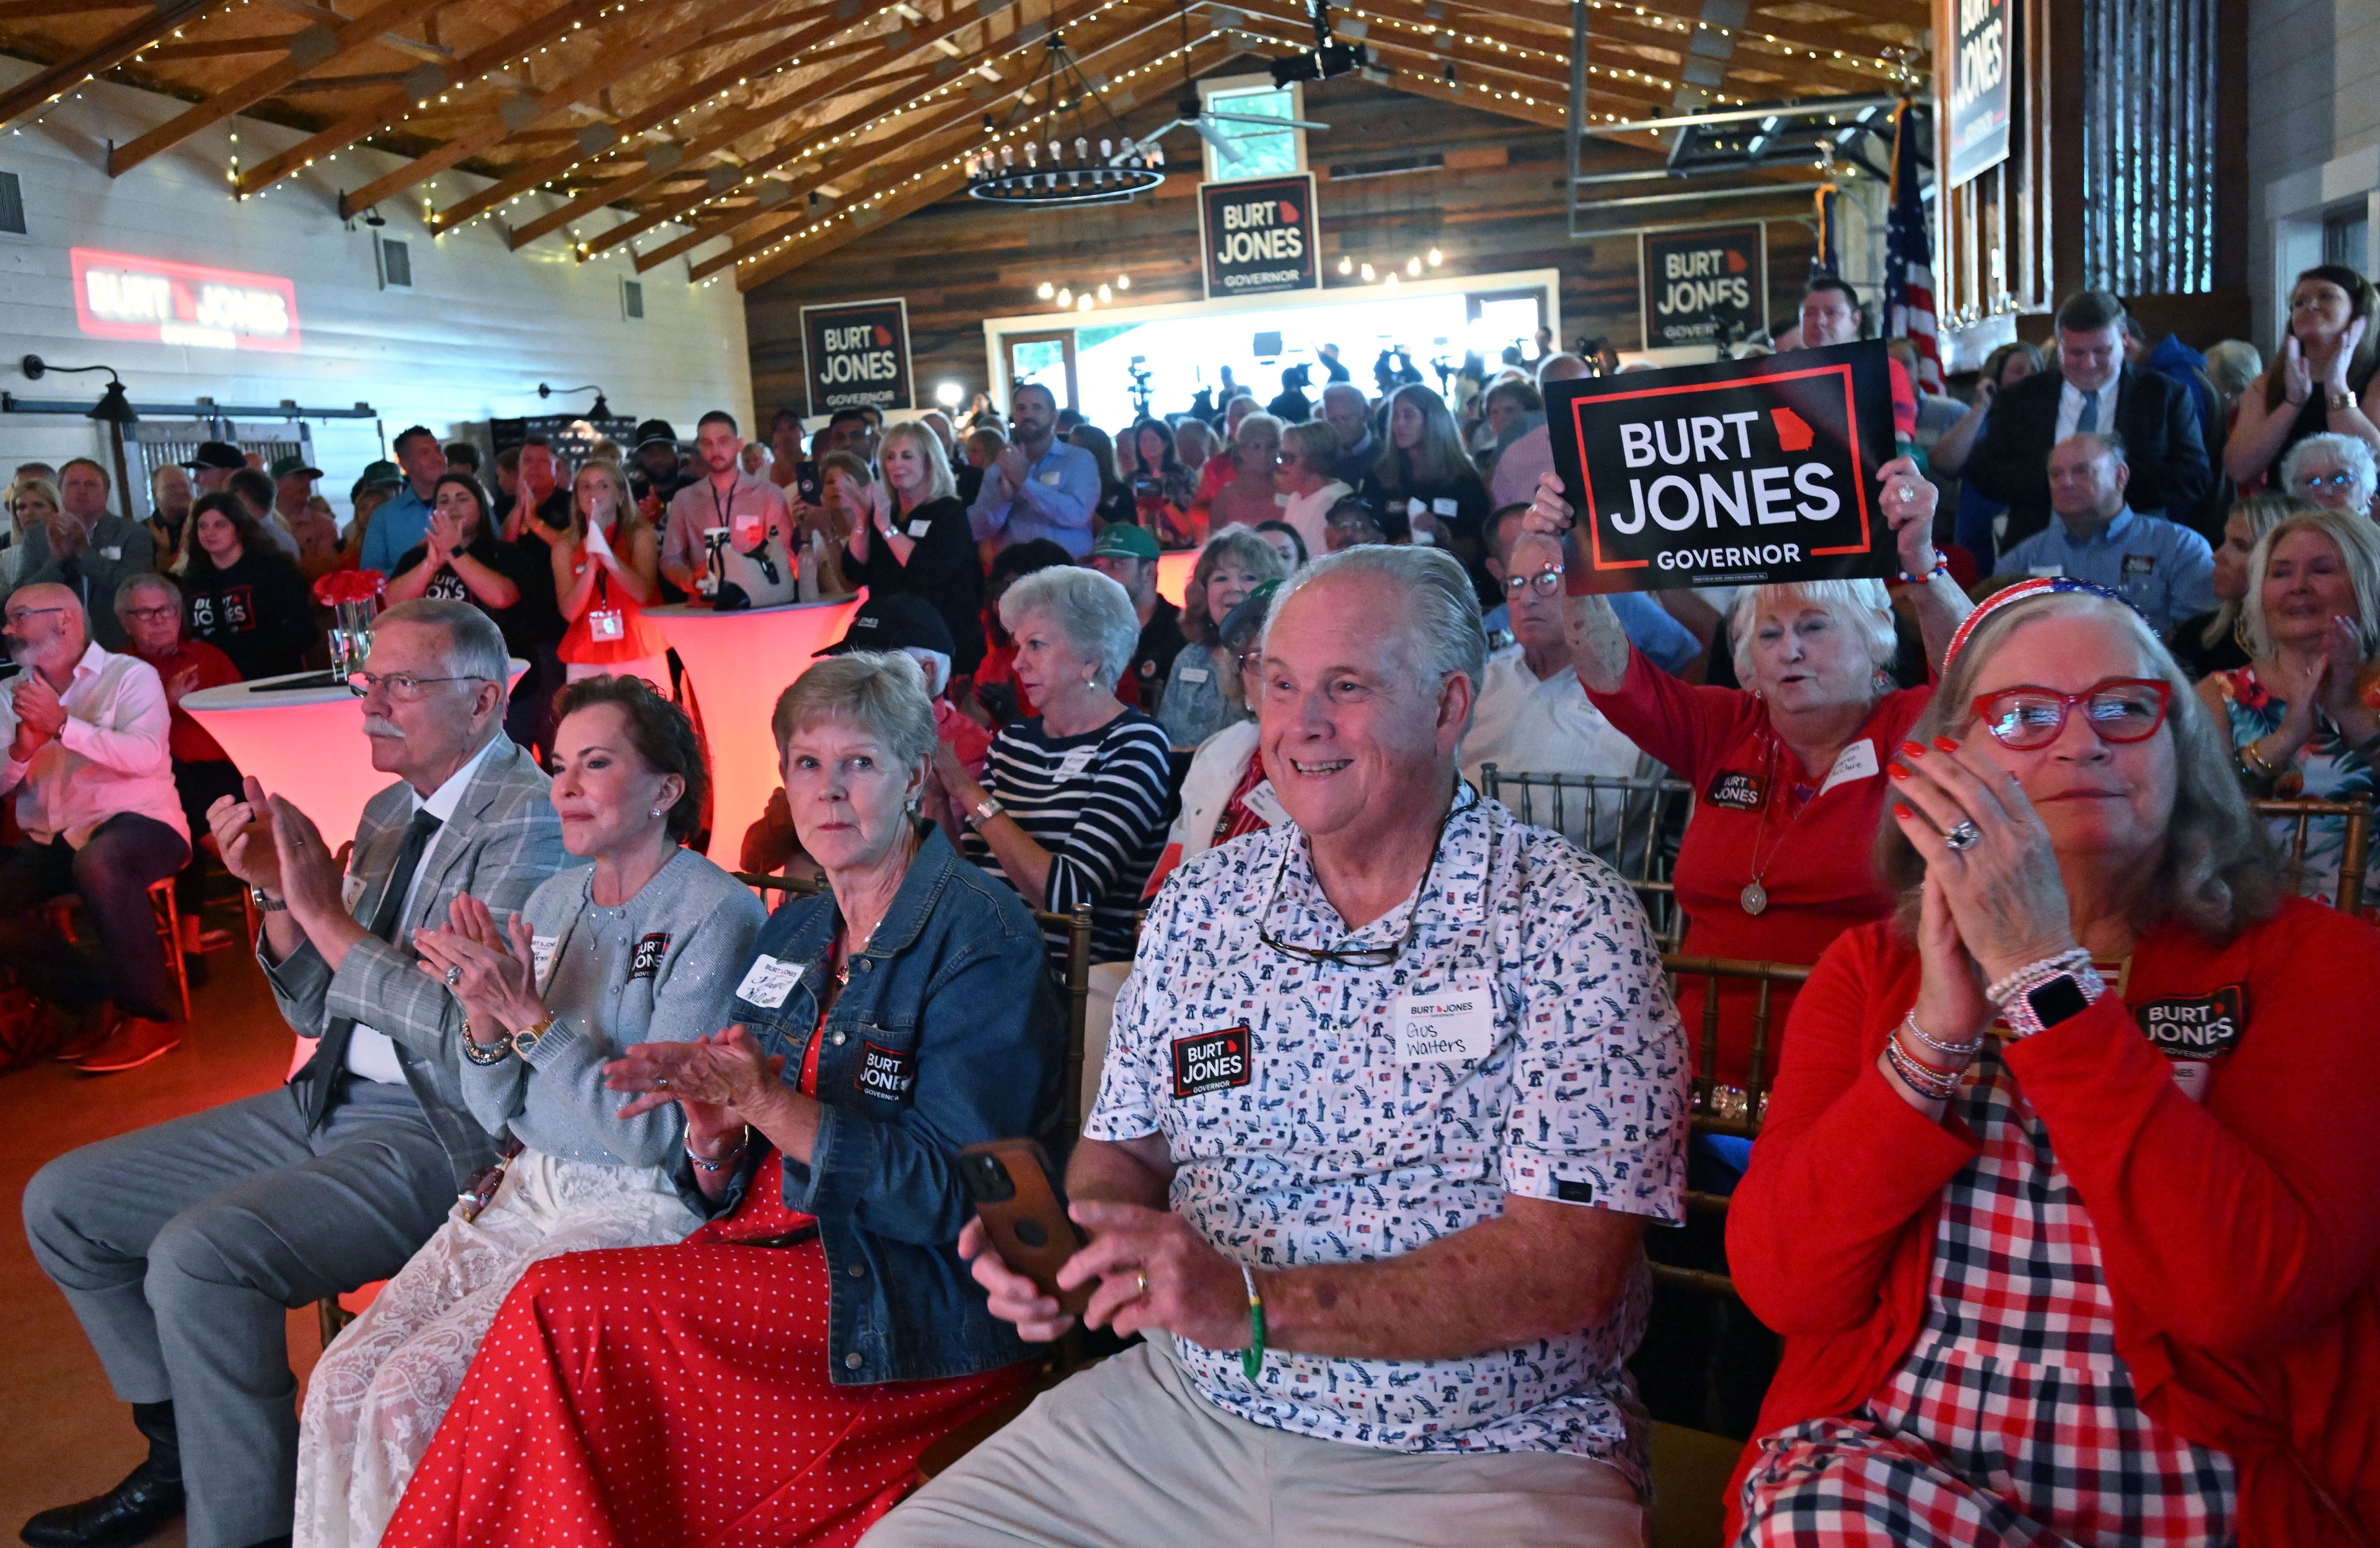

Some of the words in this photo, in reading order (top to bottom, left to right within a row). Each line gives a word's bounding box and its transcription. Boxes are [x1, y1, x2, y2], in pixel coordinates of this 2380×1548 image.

[1223, 201, 1277, 229] BURT
[1217, 227, 1303, 264] JONES
[1665, 249, 1724, 279] BURT
[1224, 270, 1300, 288] GOVERNOR
[86, 271, 169, 319] BURT
[196, 285, 289, 333] JONES
[1657, 277, 1750, 315] JONES
[824, 325, 872, 352] BURT
[820, 350, 897, 384] JONES
[826, 390, 894, 407] GOVERNOR
[1620, 410, 1758, 468] BURT
[1611, 462, 1840, 534] JONES
[1657, 543, 1801, 571] GOVERNOR
[195, 595, 233, 609] BUT
[193, 605, 247, 627] JOES
[1714, 786, 1758, 803] JONES
[632, 954, 665, 971] JONE
[764, 964, 781, 974] BURT
[1411, 1005, 1435, 1014] BURT
[1443, 1002, 1473, 1013] JONES
[2148, 1005, 2210, 1022] BURT
[1407, 1022, 1437, 1037] Gus
[2147, 1017, 2234, 1045] JONES
[1188, 1040, 1225, 1063] BURT
[867, 1053, 902, 1073] BURT
[1183, 1055, 1242, 1084] JONES
[864, 1088, 899, 1101] GOVERNOR
[1193, 1080, 1230, 1094] GOVERNOR
